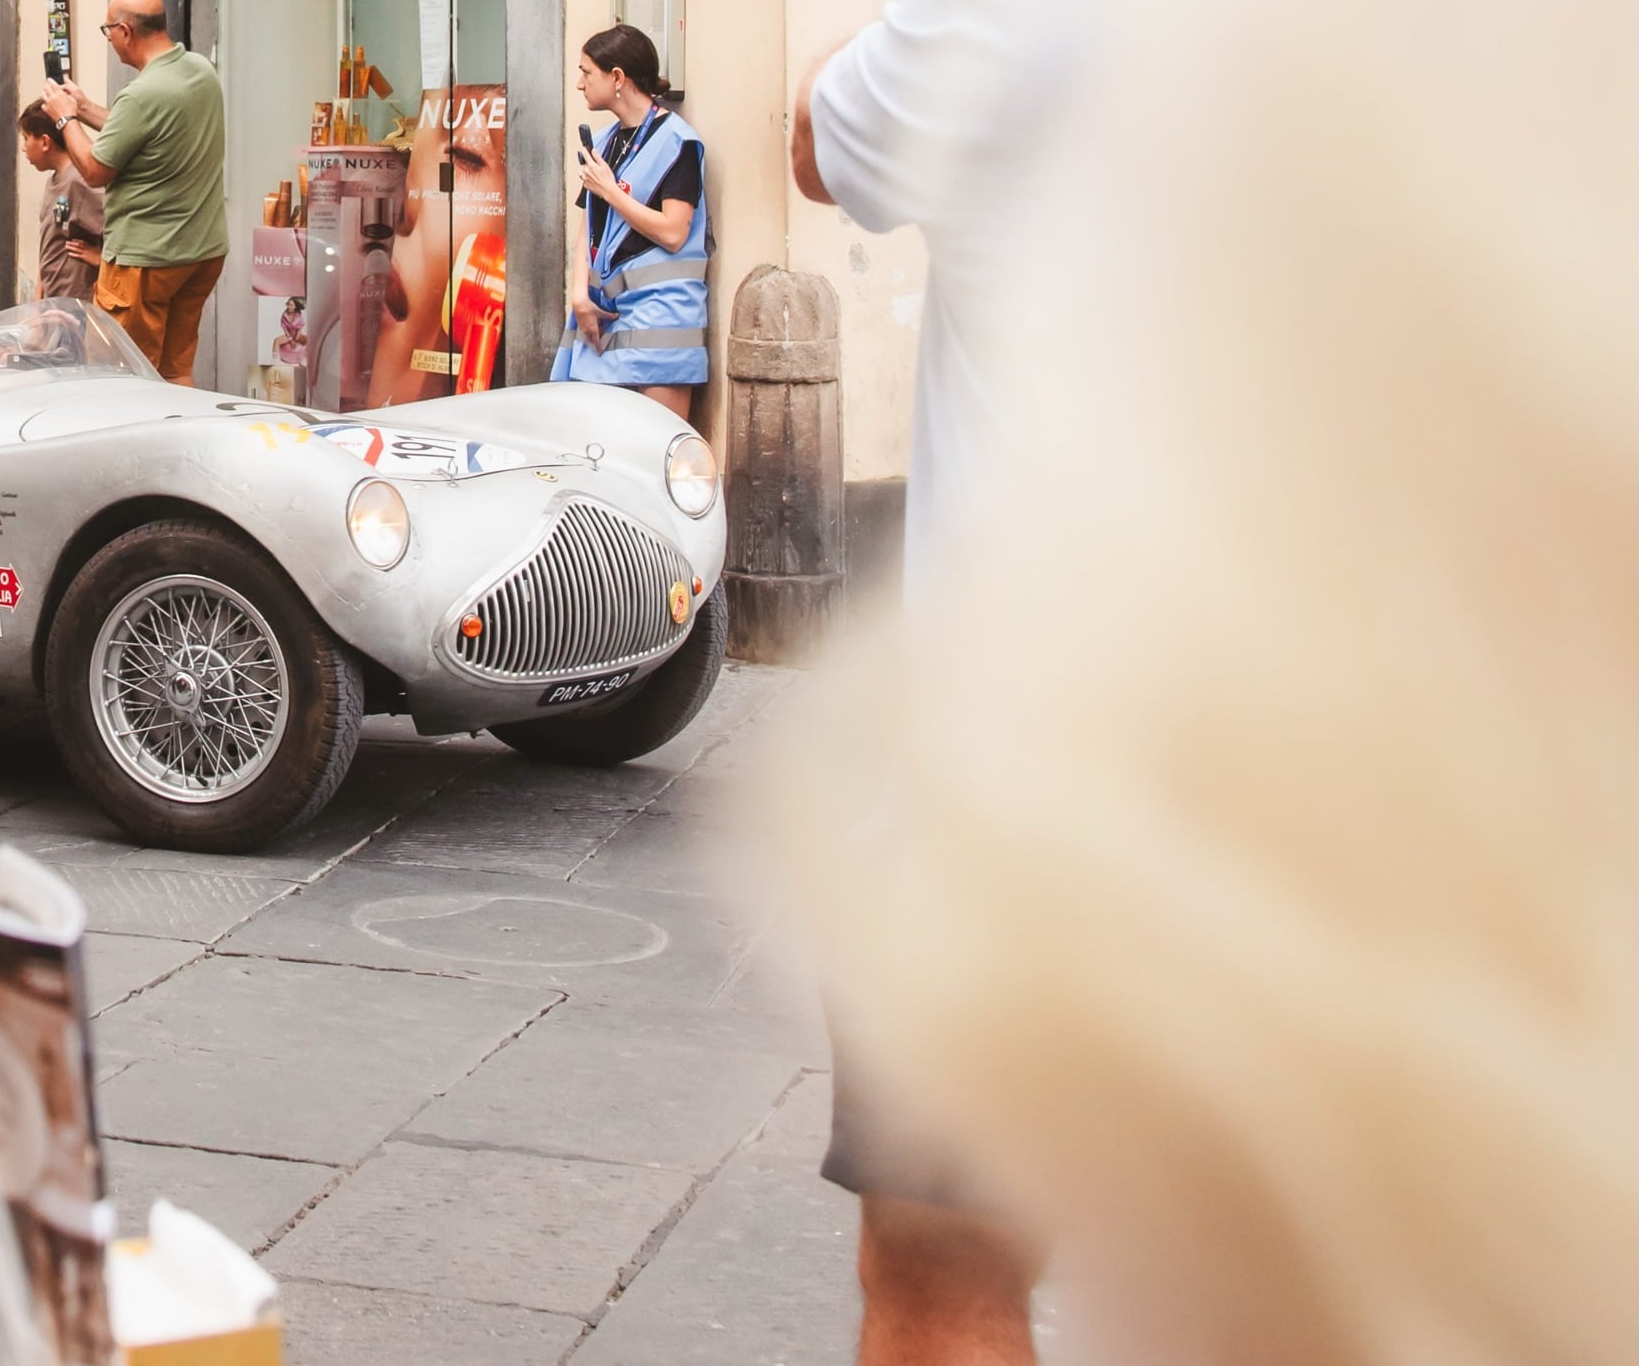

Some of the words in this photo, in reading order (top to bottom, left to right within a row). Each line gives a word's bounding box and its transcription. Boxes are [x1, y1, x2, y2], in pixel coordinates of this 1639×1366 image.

[419, 97, 506, 129] NUXE
[308, 158, 332, 169] NUXE
[345, 158, 396, 169] NUXE
[254, 255, 291, 266] NUXE
[389, 434, 457, 460] 191
[548, 673, 630, 702] PM-74-90
